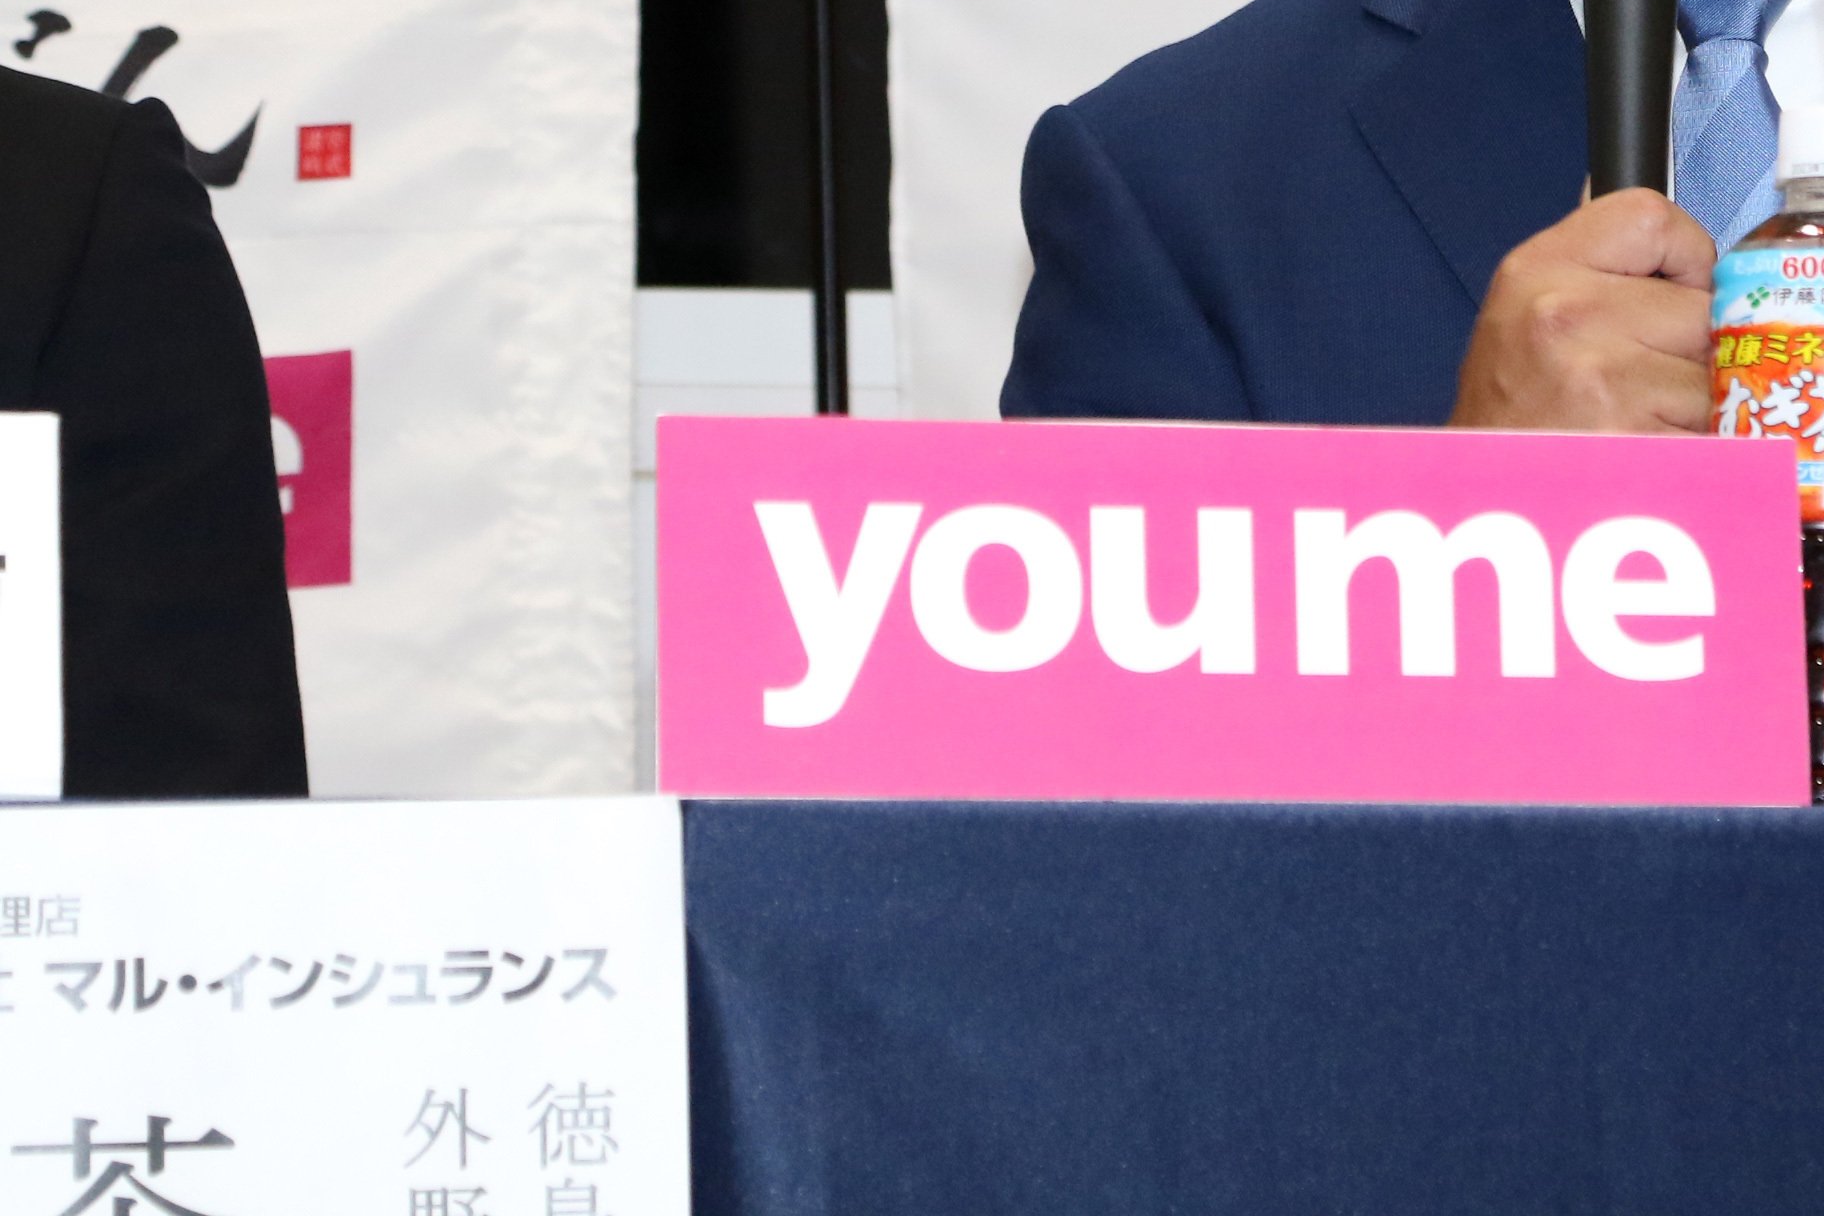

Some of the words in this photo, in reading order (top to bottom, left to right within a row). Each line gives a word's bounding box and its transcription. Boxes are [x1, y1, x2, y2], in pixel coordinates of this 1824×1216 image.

[44, 947, 618, 1014] マル・インシュランス
